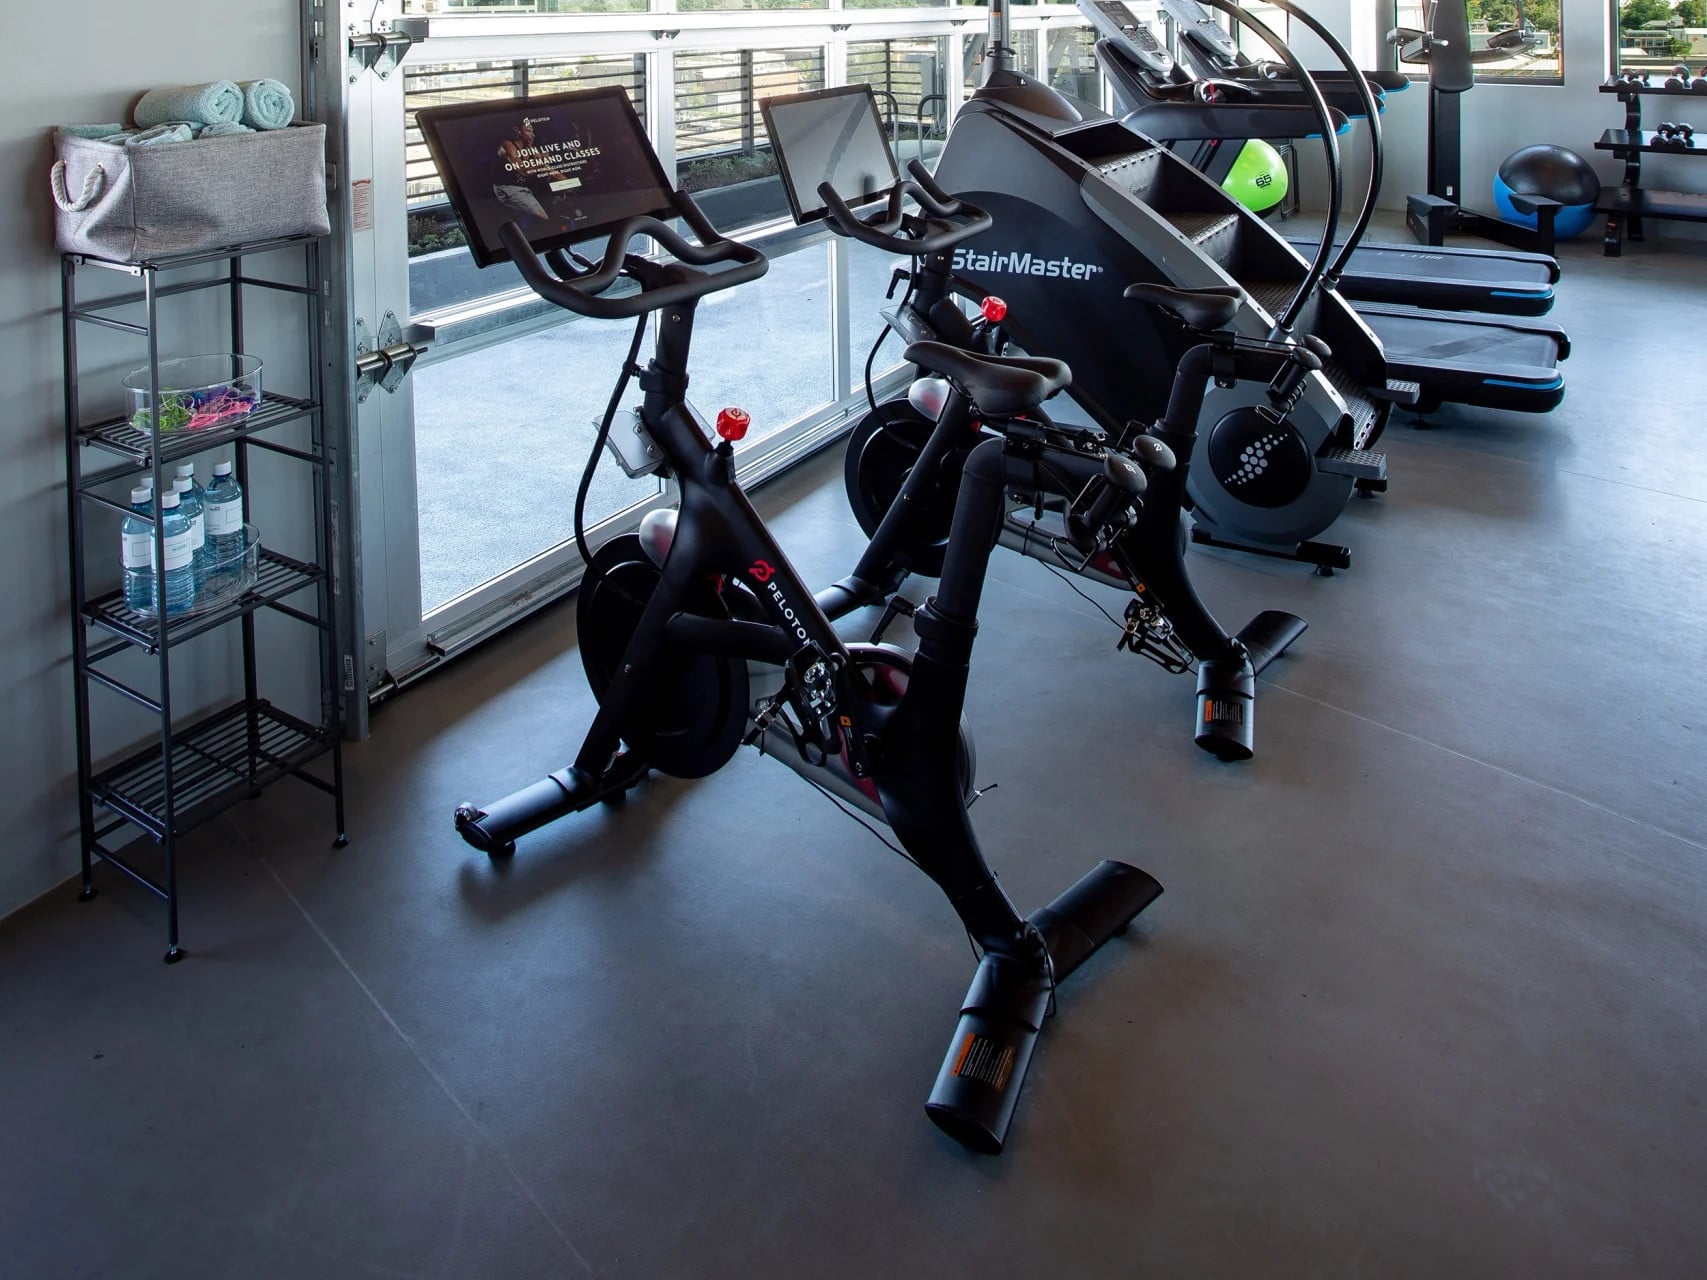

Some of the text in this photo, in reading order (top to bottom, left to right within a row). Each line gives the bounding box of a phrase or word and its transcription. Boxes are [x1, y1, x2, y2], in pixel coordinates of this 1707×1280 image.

[516, 140, 581, 158] JOIN LIVE AND
[504, 147, 601, 171] ON-DEMAND CLASSES
[1255, 174, 1272, 187] 65
